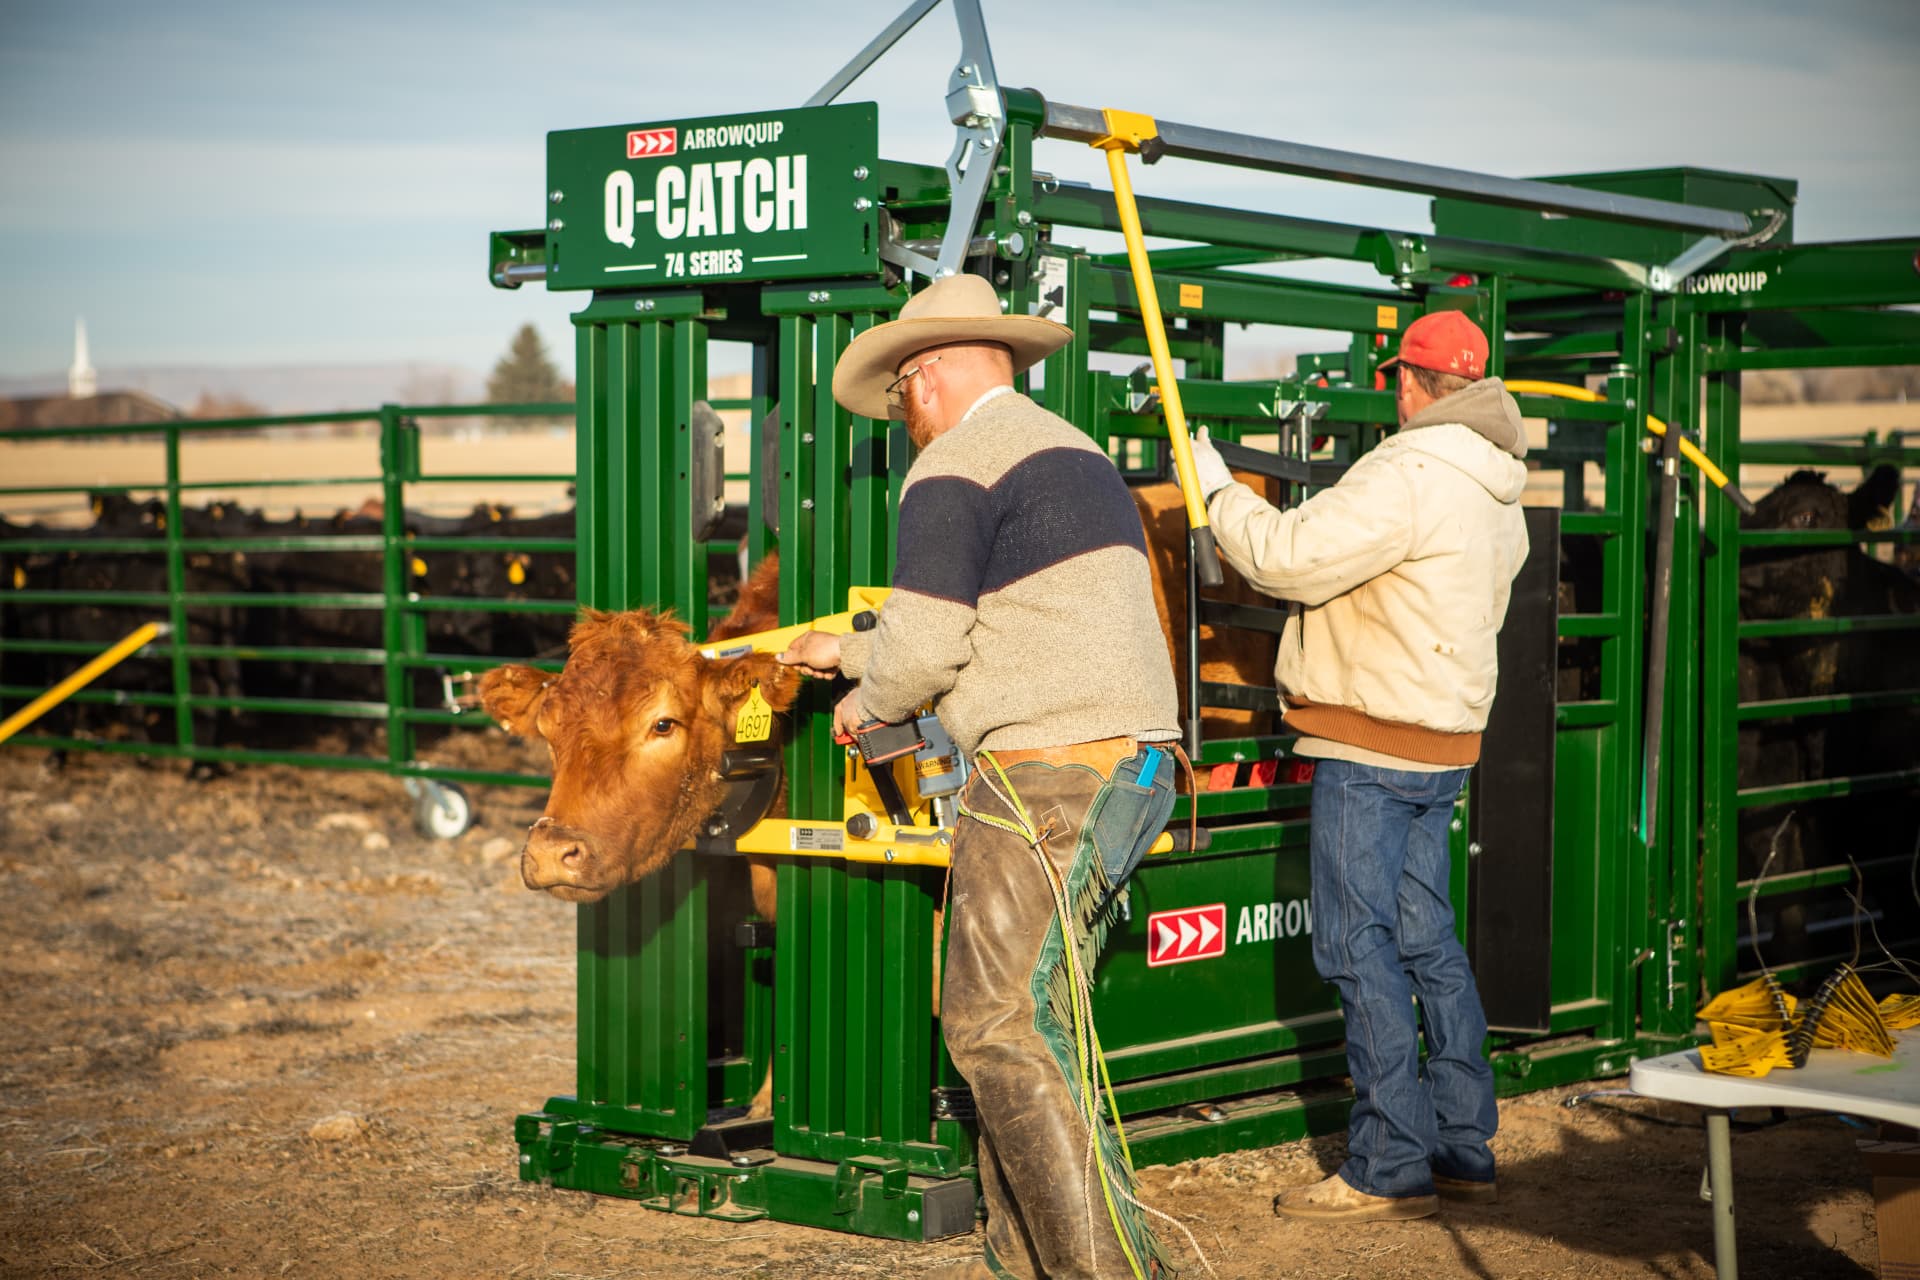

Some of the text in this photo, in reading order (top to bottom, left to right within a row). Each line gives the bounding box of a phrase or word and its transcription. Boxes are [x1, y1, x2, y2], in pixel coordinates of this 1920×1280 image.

[683, 121, 783, 150] ARROWQUIP
[604, 154, 807, 248] Q-CATCH
[665, 249, 743, 277] 74 SERIES
[1680, 271, 1767, 295] ROWQUIP
[737, 714, 769, 738] 4697
